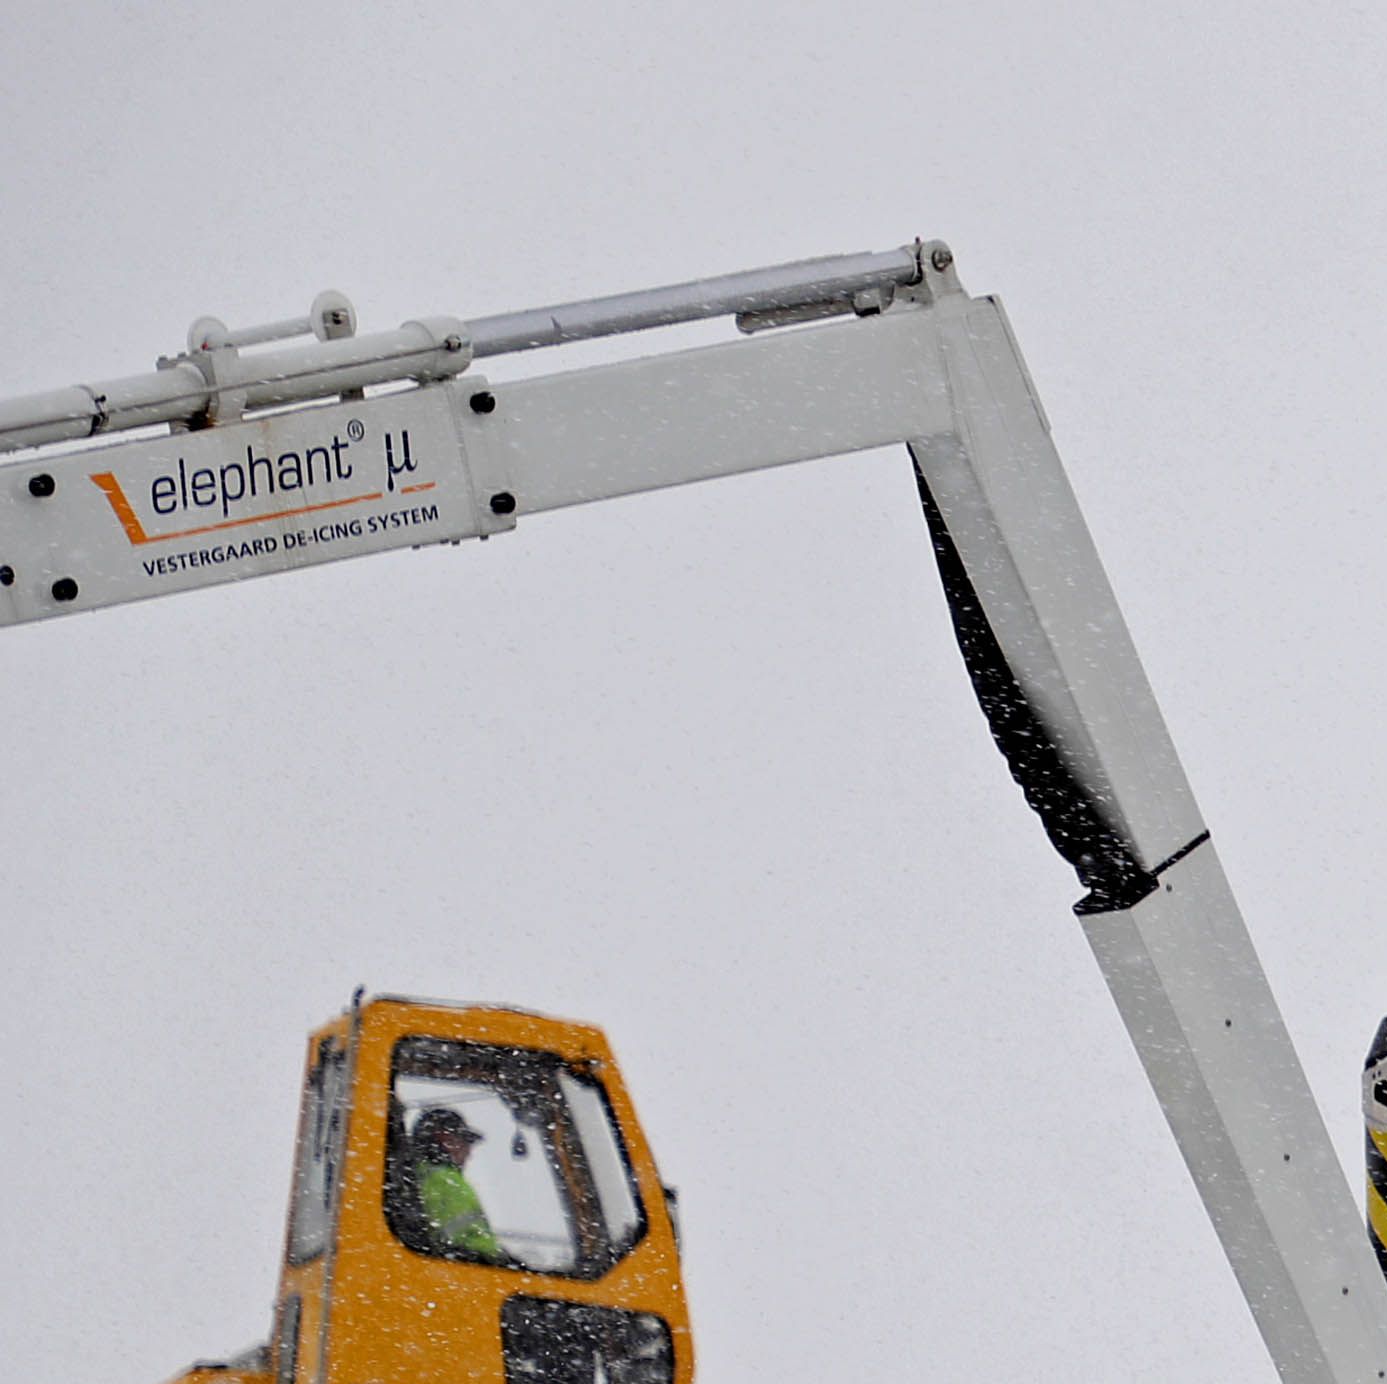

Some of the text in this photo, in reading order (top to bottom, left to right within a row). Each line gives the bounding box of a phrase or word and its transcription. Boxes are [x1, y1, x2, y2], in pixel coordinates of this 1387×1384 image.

[142, 504, 440, 577] VESTERGAARD DE-ICING SYSTEM
